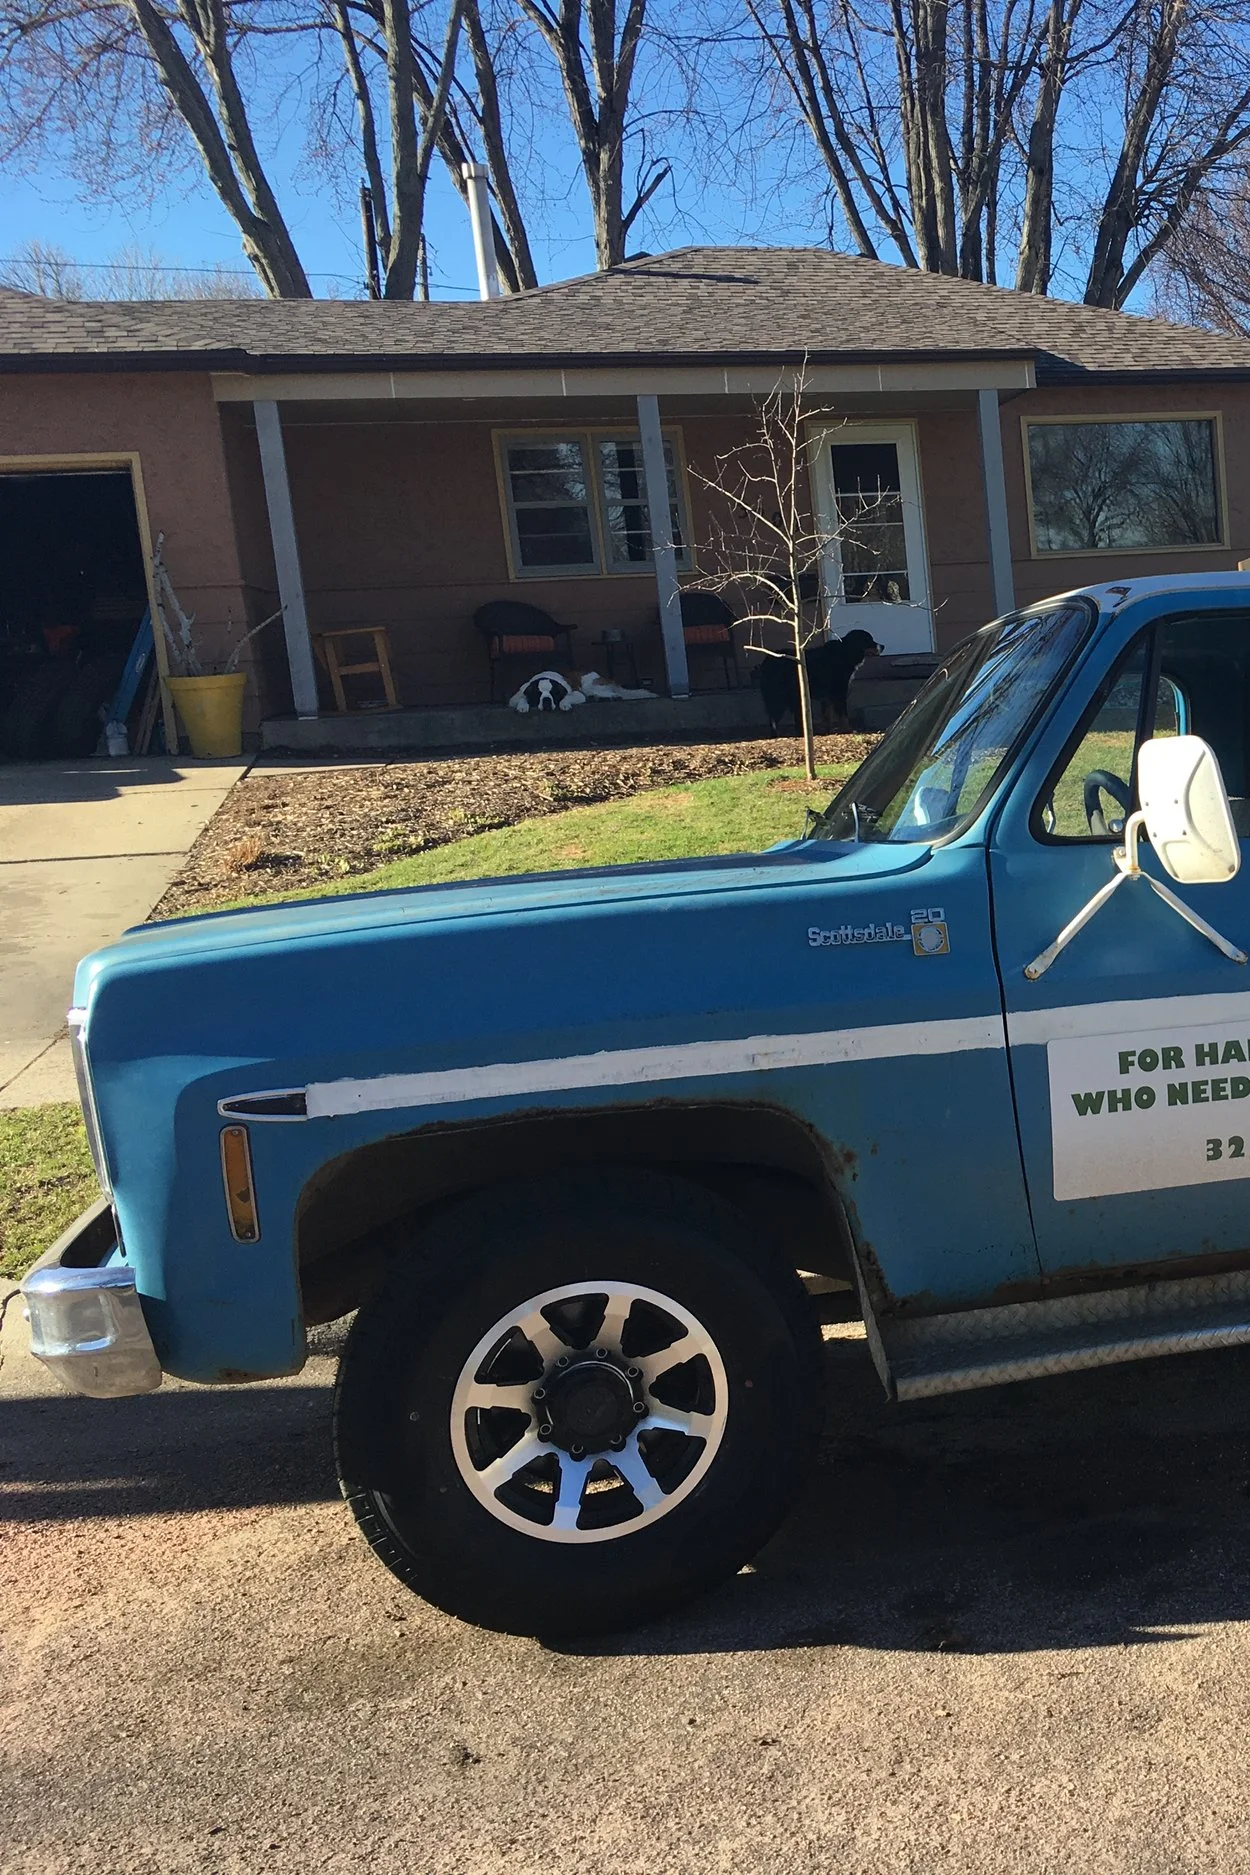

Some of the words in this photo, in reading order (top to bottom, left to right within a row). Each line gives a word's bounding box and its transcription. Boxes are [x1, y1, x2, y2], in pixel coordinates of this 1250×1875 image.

[910, 907, 946, 923] 20
[807, 922, 905, 947] Scottsdale
[1117, 1045, 1186, 1075] FOR
[1071, 1085, 1157, 1117] WHO
